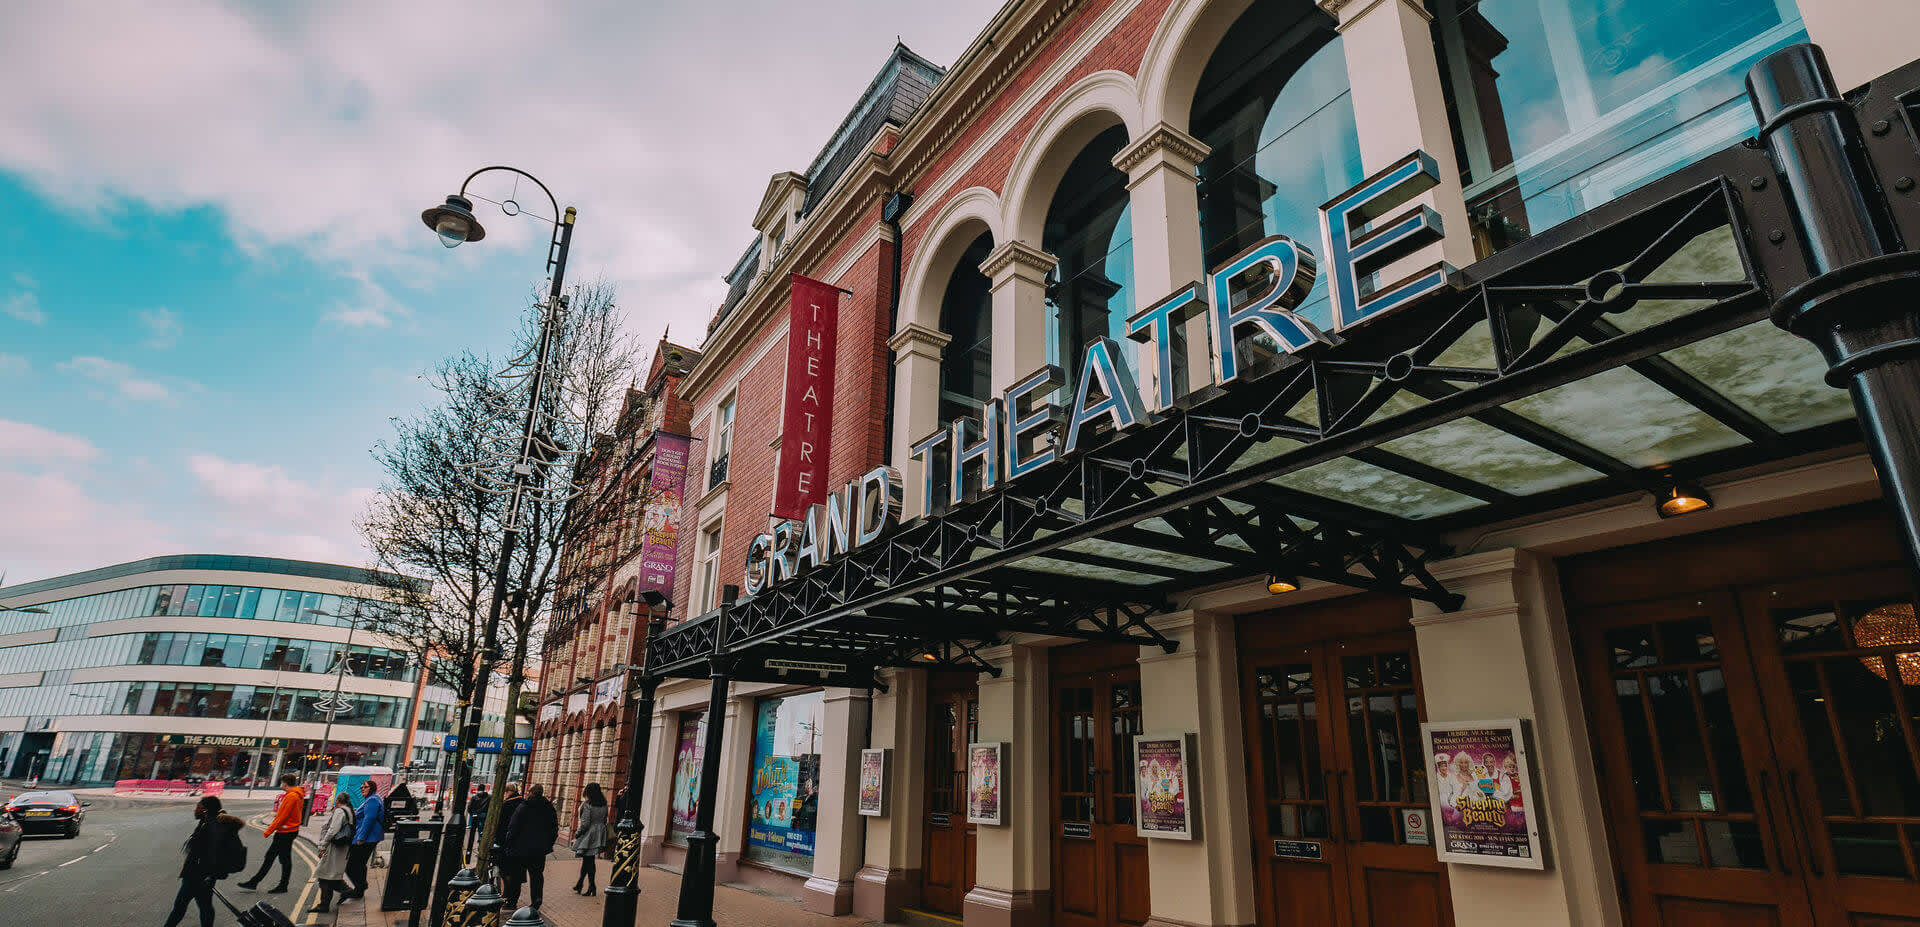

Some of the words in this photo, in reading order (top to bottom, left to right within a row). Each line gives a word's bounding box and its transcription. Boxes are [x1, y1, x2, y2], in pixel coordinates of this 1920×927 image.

[744, 466, 902, 597] GRAND
[910, 149, 1460, 520] THEATRE
[799, 302, 821, 494] THEATRE
[643, 562, 673, 573] GRAND
[184, 735, 204, 745] THE
[204, 736, 257, 747] SUNBEAM
[1456, 795, 1507, 813] Sleeping
[1462, 807, 1507, 827] Beauty
[1450, 840, 1477, 850] GRAND
